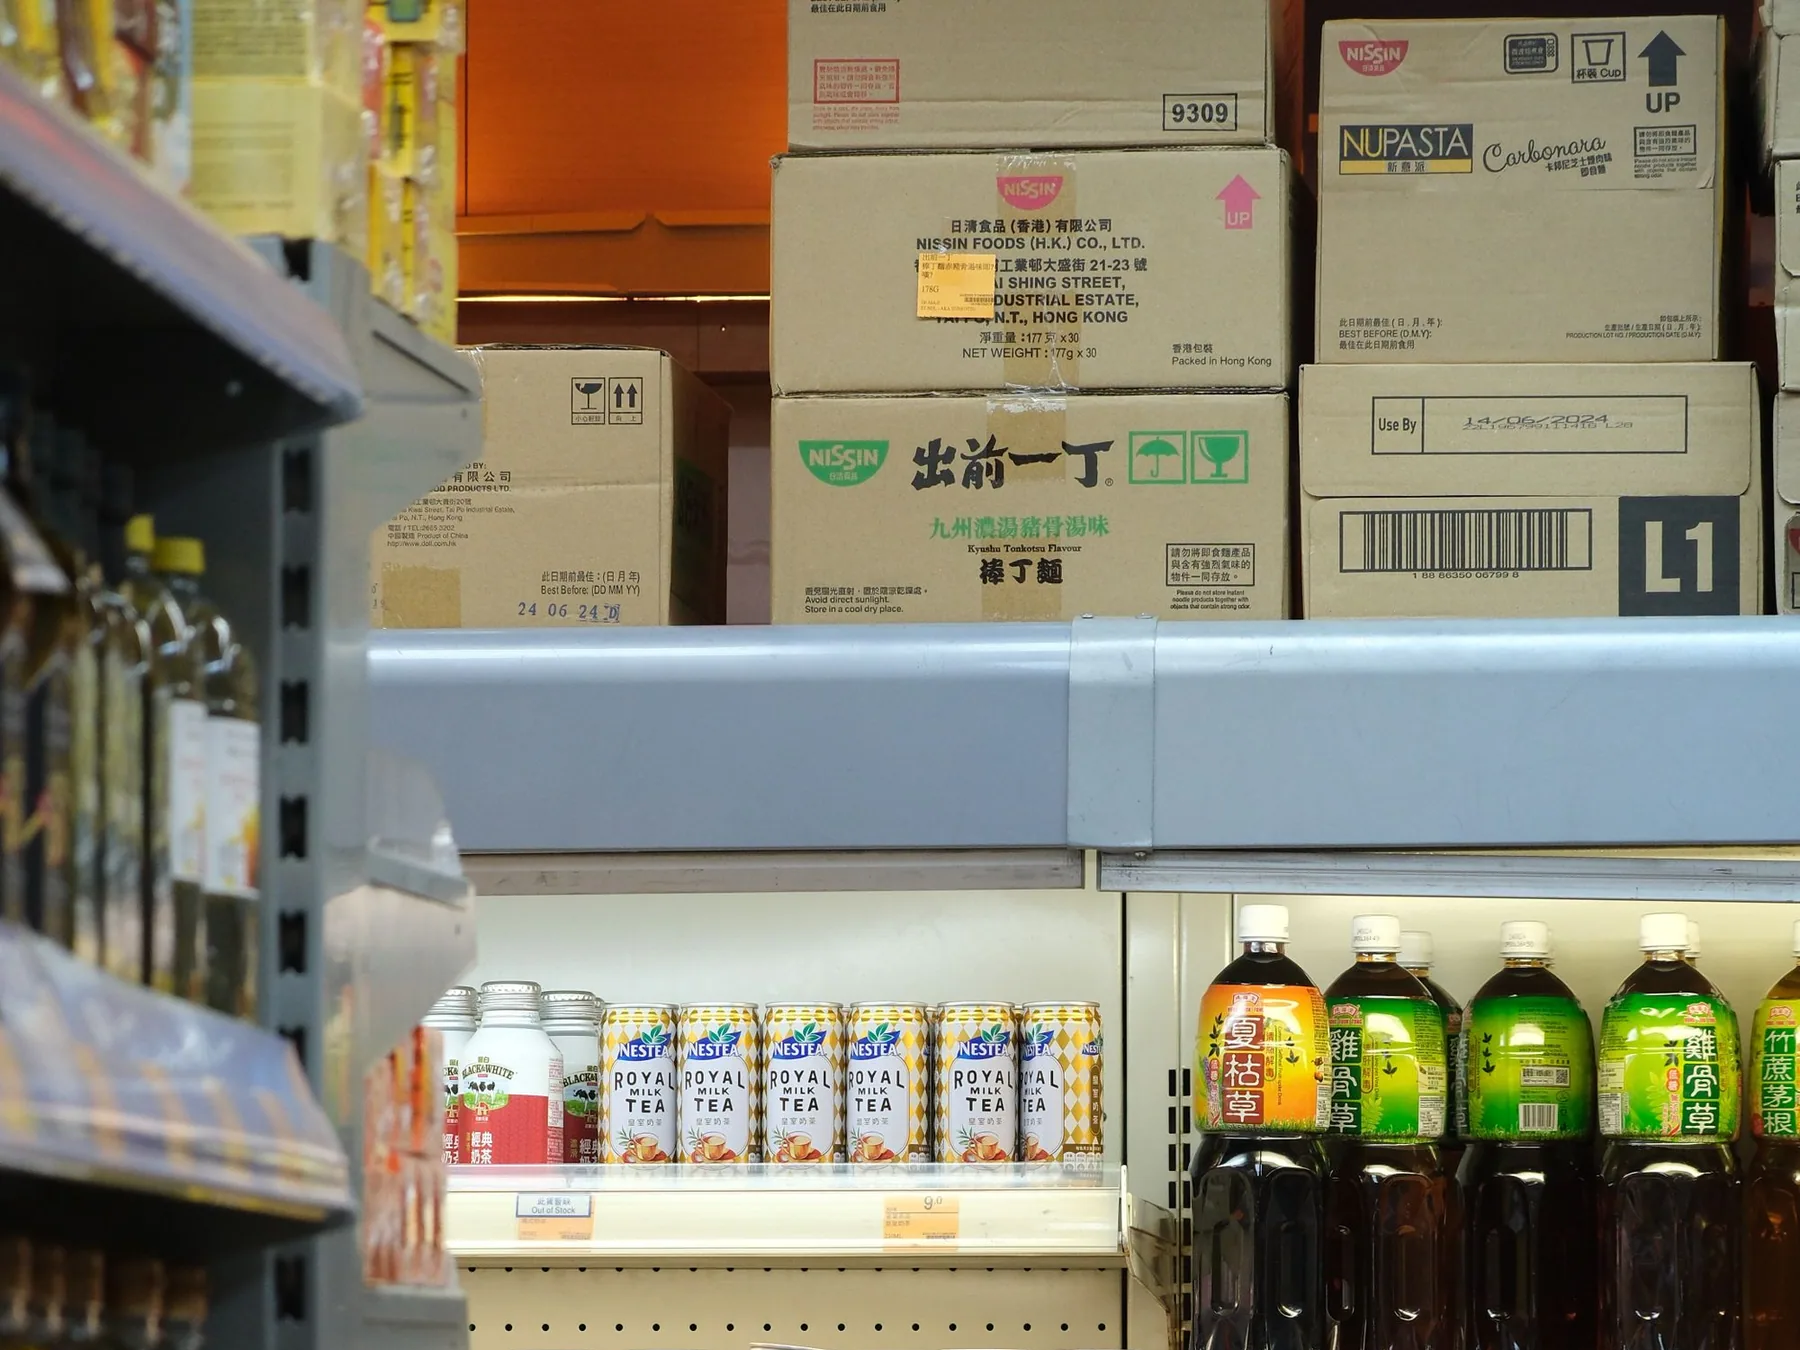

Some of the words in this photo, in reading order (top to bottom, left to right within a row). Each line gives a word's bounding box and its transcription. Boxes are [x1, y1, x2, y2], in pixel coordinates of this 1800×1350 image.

[1346, 44, 1401, 64] NISSIN
[1600, 66, 1622, 80] Cup
[1646, 92, 1681, 114] UP
[1172, 103, 1229, 124] 9309
[1343, 128, 1469, 158] NUPASTA
[1483, 137, 1607, 173] Carbonara
[1004, 180, 1057, 199] NISSIN
[1226, 211, 1250, 226] UP
[917, 238, 968, 251] NISSIN
[973, 238, 1025, 250] FOODS
[1030, 238, 1071, 252] (H.K.)
[1079, 238, 1108, 252] CO.,
[1113, 238, 1145, 250] LTD.
[1090, 260, 1130, 272] 21-23
[1134, 259, 1148, 273] 號
[1008, 277, 1057, 290] SHING
[1062, 277, 1126, 292] STREET,
[994, 294, 1070, 307] DUSTRIAL
[1075, 294, 1140, 308] ESTATE,
[1033, 311, 1079, 324] HONG
[1083, 311, 1129, 323] KONG
[1339, 330, 1361, 338] BEST
[1364, 330, 1398, 338] BEFORE
[962, 348, 988, 358] NET
[992, 347, 1041, 359] WEIGHT
[1051, 347, 1074, 361] 177g
[1086, 347, 1097, 358] 30
[1172, 356, 1207, 366] Packed
[1210, 356, 1219, 366] in
[1220, 356, 1245, 368] Hong
[1248, 356, 1272, 368] Kong
[1378, 418, 1400, 432] Use
[1403, 418, 1417, 434] By
[1465, 414, 1609, 425] 14/06/2024
[809, 443, 879, 472] NISSIN
[911, 434, 1115, 491] 出前一丁
[447, 485, 491, 493] PRODUCTS
[428, 515, 445, 523] Hong
[930, 515, 1110, 540] 九州濃湯豬骨湯味
[967, 544, 1001, 555] Kyushu
[1004, 544, 1046, 553] Tonkotsu
[1048, 544, 1082, 553] Flavour
[1645, 520, 1714, 592] L1
[541, 585, 559, 595] Best
[560, 585, 589, 595] Before:
[592, 585, 606, 597] (DD
[609, 585, 623, 595] MM
[626, 585, 640, 597] YY)
[805, 596, 828, 604] Avoid
[830, 596, 853, 604] direct
[855, 596, 890, 605] sunlight.
[518, 602, 537, 617] 24
[548, 603, 568, 618] 06
[579, 605, 598, 620] 24
[805, 605, 827, 613] Store
[829, 605, 837, 613] in
[845, 605, 862, 613] cool
[864, 605, 878, 615] dry
[879, 605, 904, 615] place.
[618, 1043, 669, 1058] NESTEA
[687, 1042, 740, 1057] NESTEA
[772, 1042, 825, 1057] NESTEA
[851, 1042, 899, 1057] NESTEA
[959, 1042, 1009, 1057] NESTEA
[1224, 1018, 1262, 1123] 夏枯草
[615, 1071, 675, 1091] ROYAL
[685, 1071, 745, 1090] ROYAL
[770, 1070, 831, 1089] ROYAL
[849, 1070, 905, 1089] ROYAL
[954, 1070, 1013, 1089] ROYAL
[1763, 1030, 1795, 1134] 竹蔗茅根
[630, 1088, 661, 1096] MILK
[697, 1087, 730, 1095] MILK
[783, 1087, 815, 1095] MILK
[858, 1086, 887, 1095] MILK
[970, 1086, 1001, 1095] MILK
[626, 1099, 666, 1113] TEA
[694, 1097, 734, 1112] TEA
[779, 1097, 819, 1112] TEA
[855, 1097, 892, 1111] TEA
[966, 1097, 1005, 1112] TEA
[470, 1131, 493, 1148] 經典
[470, 1148, 492, 1164] 奶茶
[531, 1206, 545, 1214] Out
[547, 1206, 553, 1214] of
[554, 1206, 576, 1214] Stock
[923, 1196, 943, 1211] 9.0
